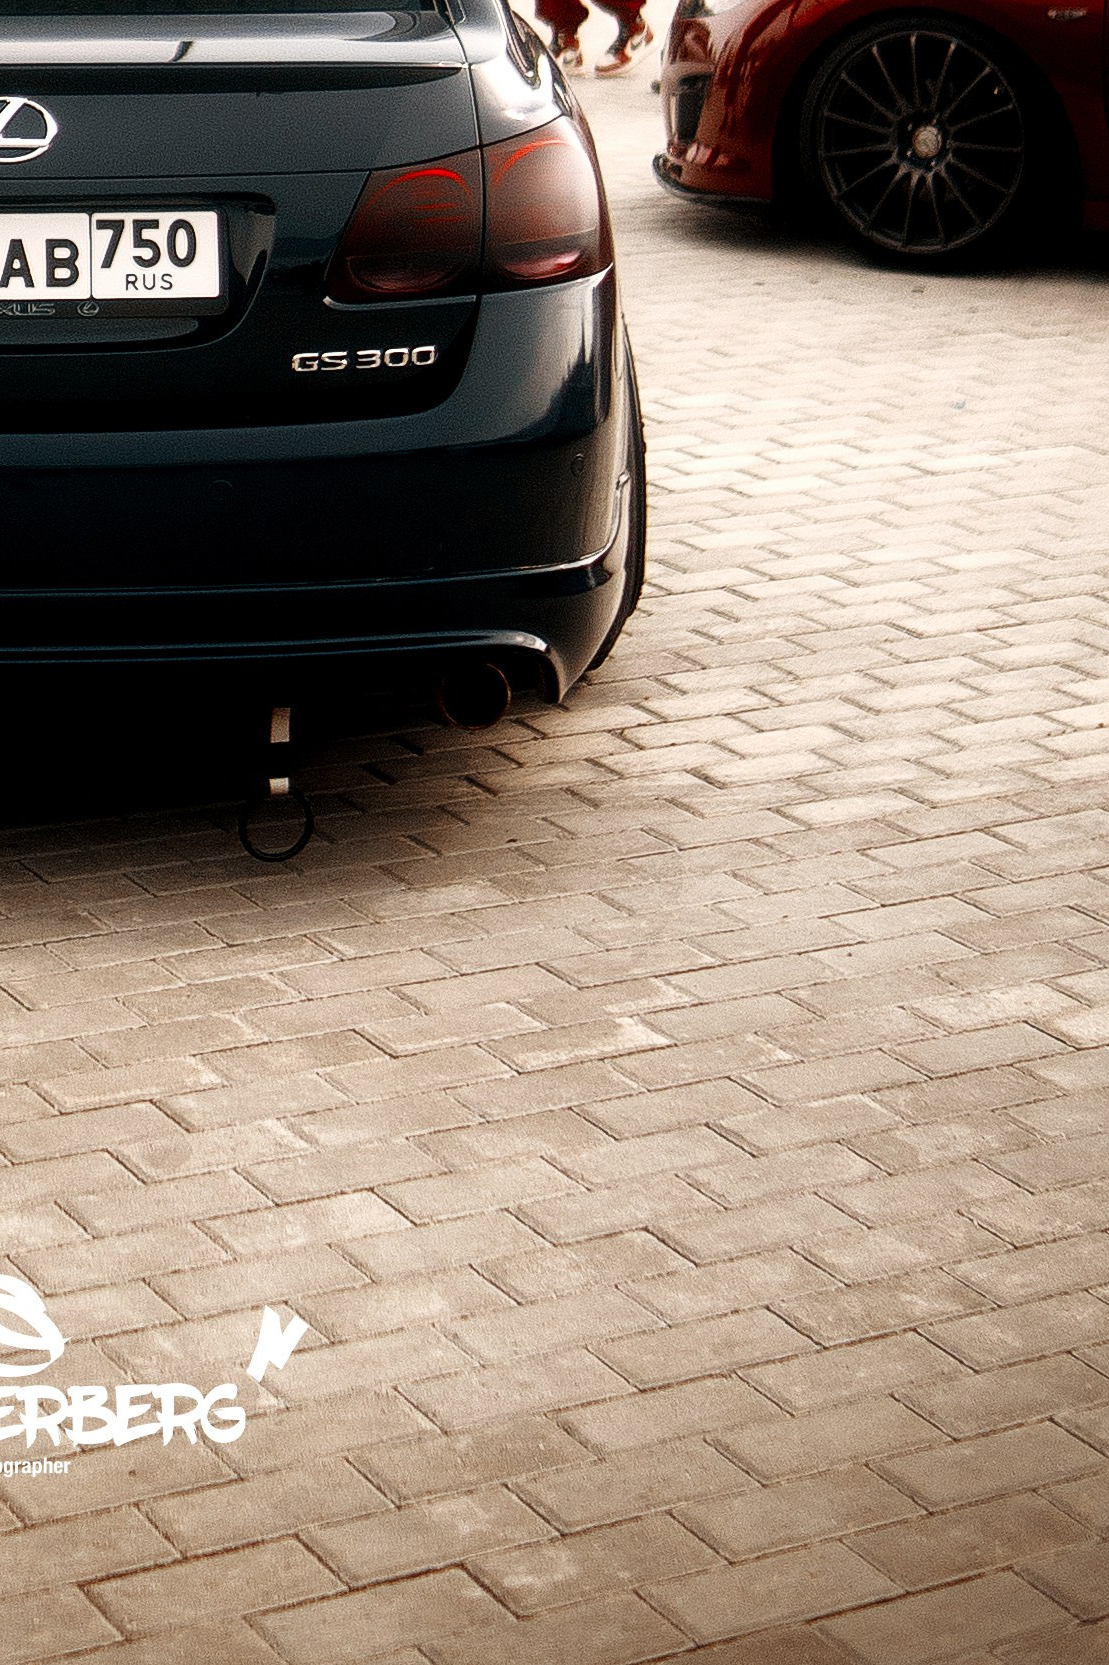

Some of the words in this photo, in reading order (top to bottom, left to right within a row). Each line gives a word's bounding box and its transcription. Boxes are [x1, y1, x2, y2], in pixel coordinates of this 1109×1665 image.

[95, 218, 197, 269] 750
[125, 273, 173, 291] RUS
[291, 351, 348, 372] GS
[355, 344, 438, 369] 300
